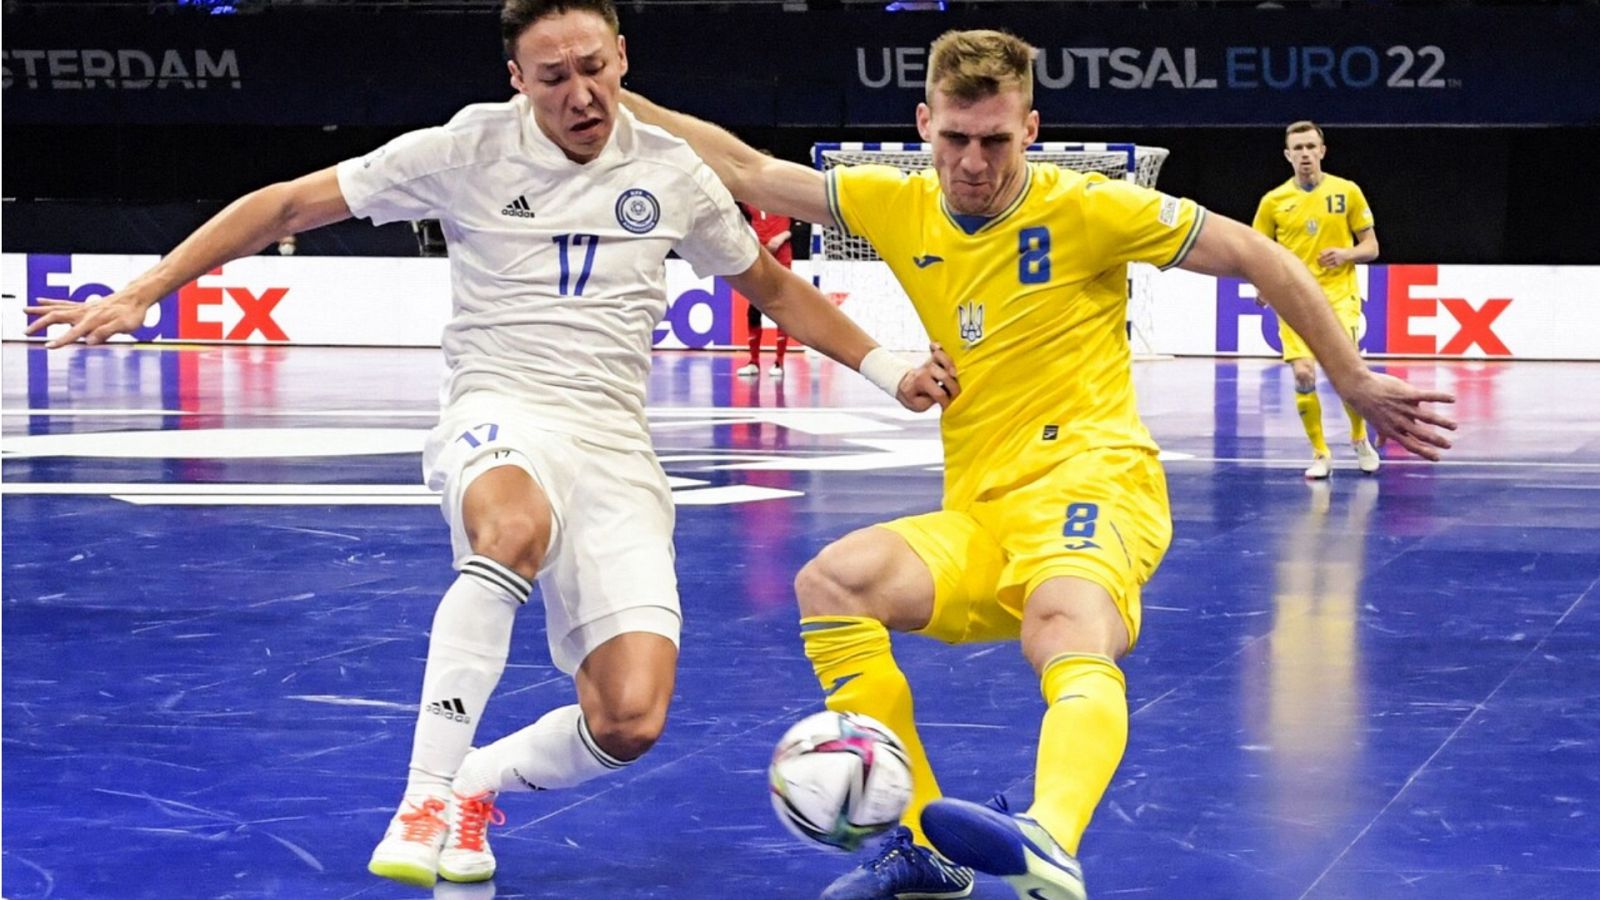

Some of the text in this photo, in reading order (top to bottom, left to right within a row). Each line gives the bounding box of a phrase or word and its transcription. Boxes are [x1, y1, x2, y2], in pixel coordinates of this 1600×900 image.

[856, 47, 925, 88] UE
[1029, 46, 1218, 90] UTSAL
[1225, 46, 1380, 88] EURO
[501, 208, 535, 218] adidas
[1326, 194, 1346, 214] 13
[552, 233, 599, 296] 17
[1019, 226, 1051, 284] 8
[455, 422, 499, 449] 17
[494, 449, 511, 459] 17
[1062, 502, 1098, 538] 8
